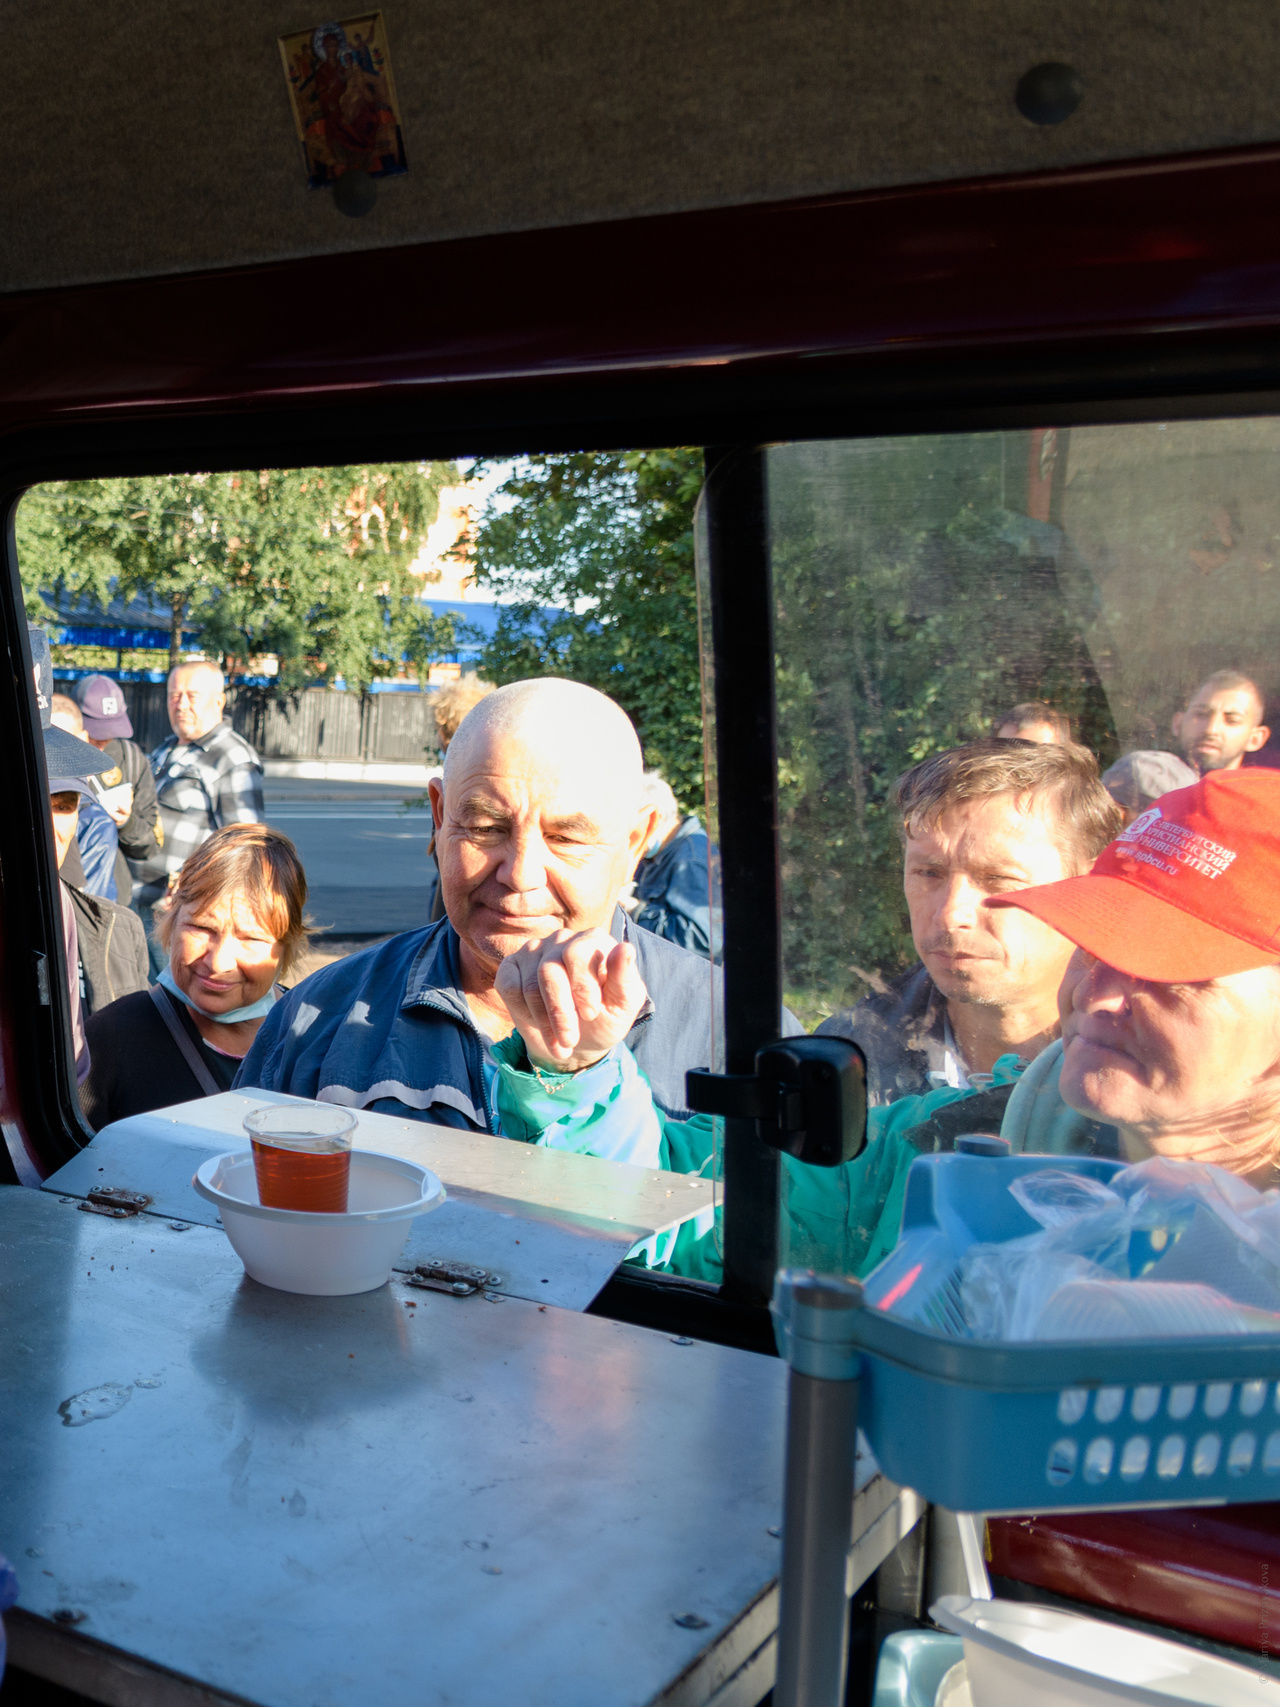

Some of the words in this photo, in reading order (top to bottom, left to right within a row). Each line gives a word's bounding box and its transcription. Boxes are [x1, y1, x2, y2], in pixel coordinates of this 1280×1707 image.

[1115, 845, 1179, 877] www.spbcu.ru
[1136, 834, 1223, 880] УНИВЕРСИТЕТ
[1146, 827, 1231, 873] ХРИСТИАНСКИЙ
[1152, 819, 1237, 863] С-ПЕТЕРБУРГСКИЙ
